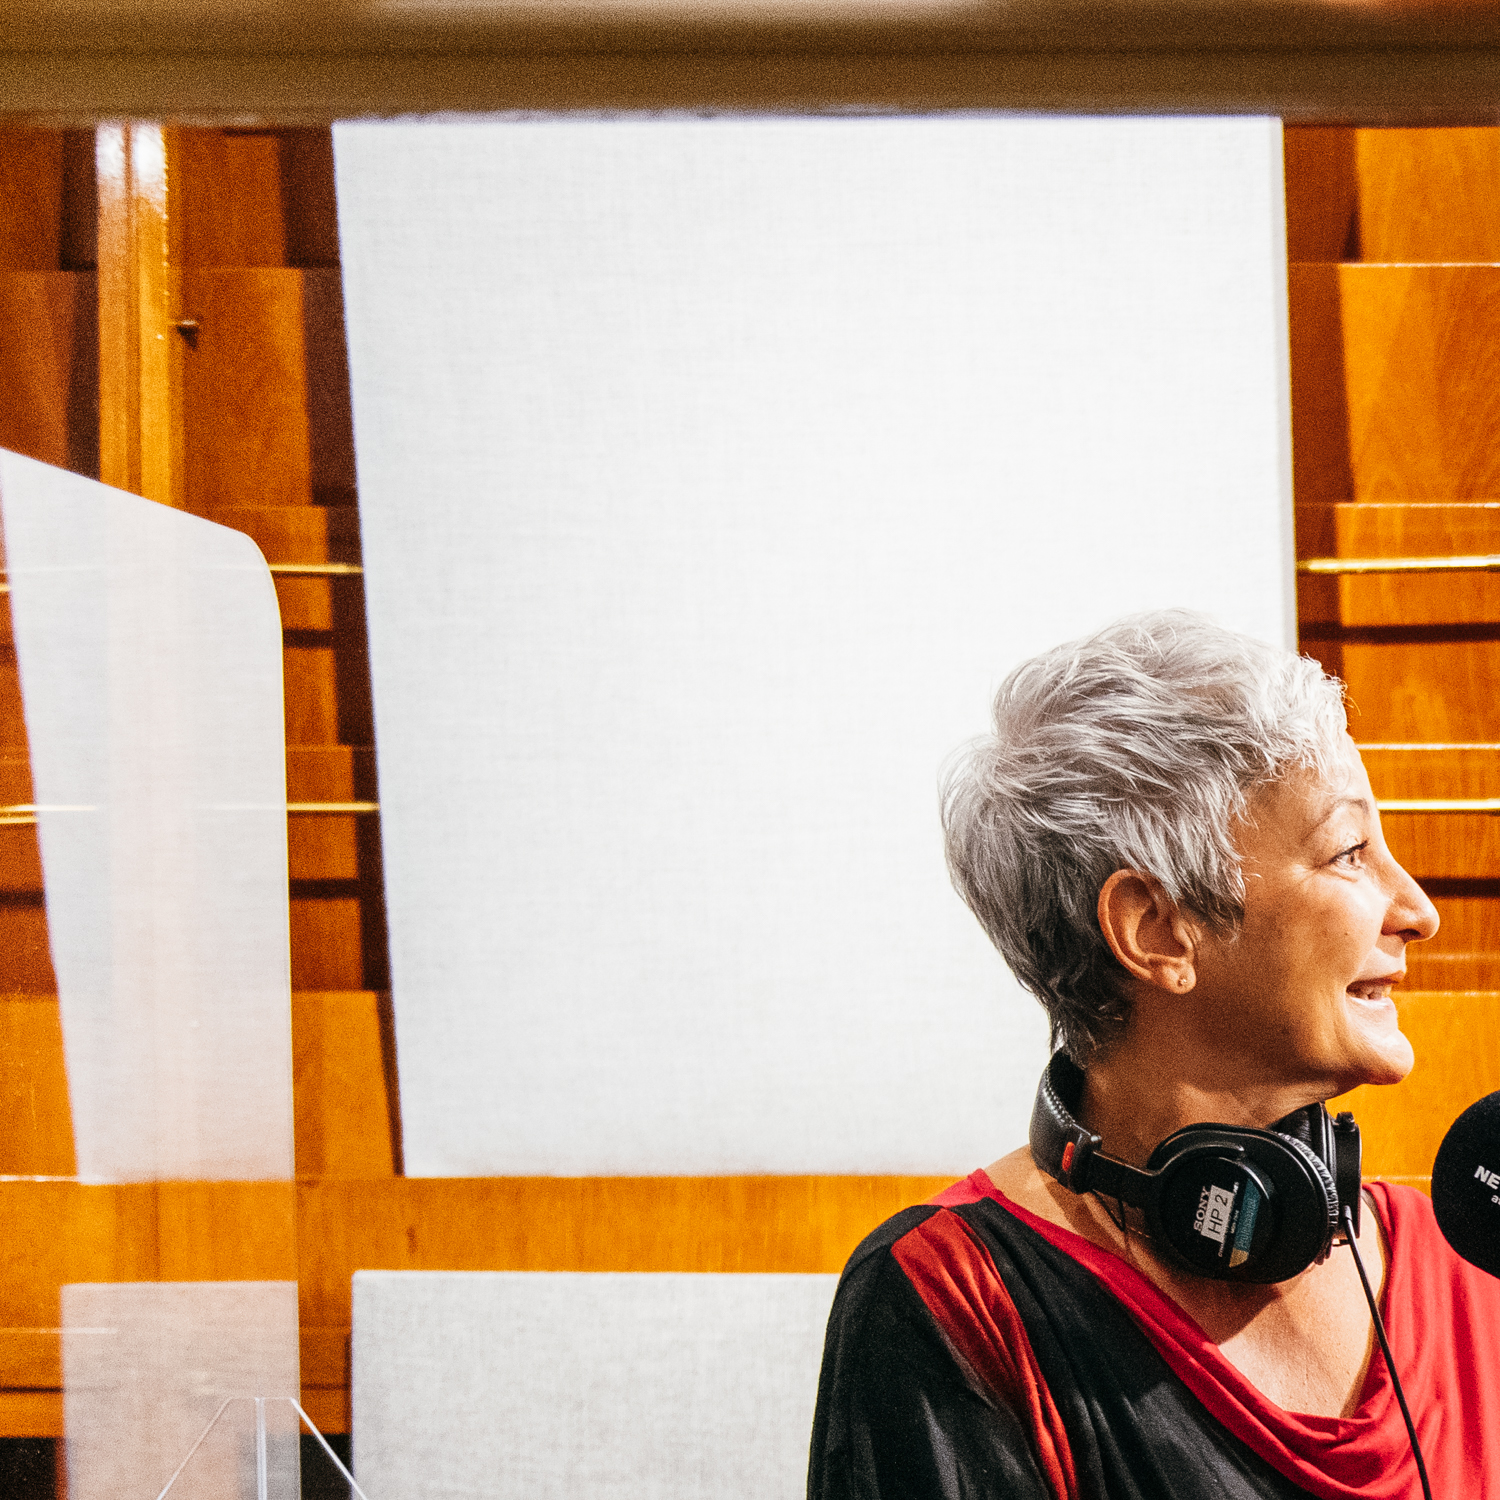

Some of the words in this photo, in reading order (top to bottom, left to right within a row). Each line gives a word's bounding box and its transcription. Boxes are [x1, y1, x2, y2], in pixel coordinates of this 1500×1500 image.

[1193, 1186, 1210, 1232] SONY
[1214, 1194, 1229, 1207] 2
[1208, 1208, 1224, 1235] HP
